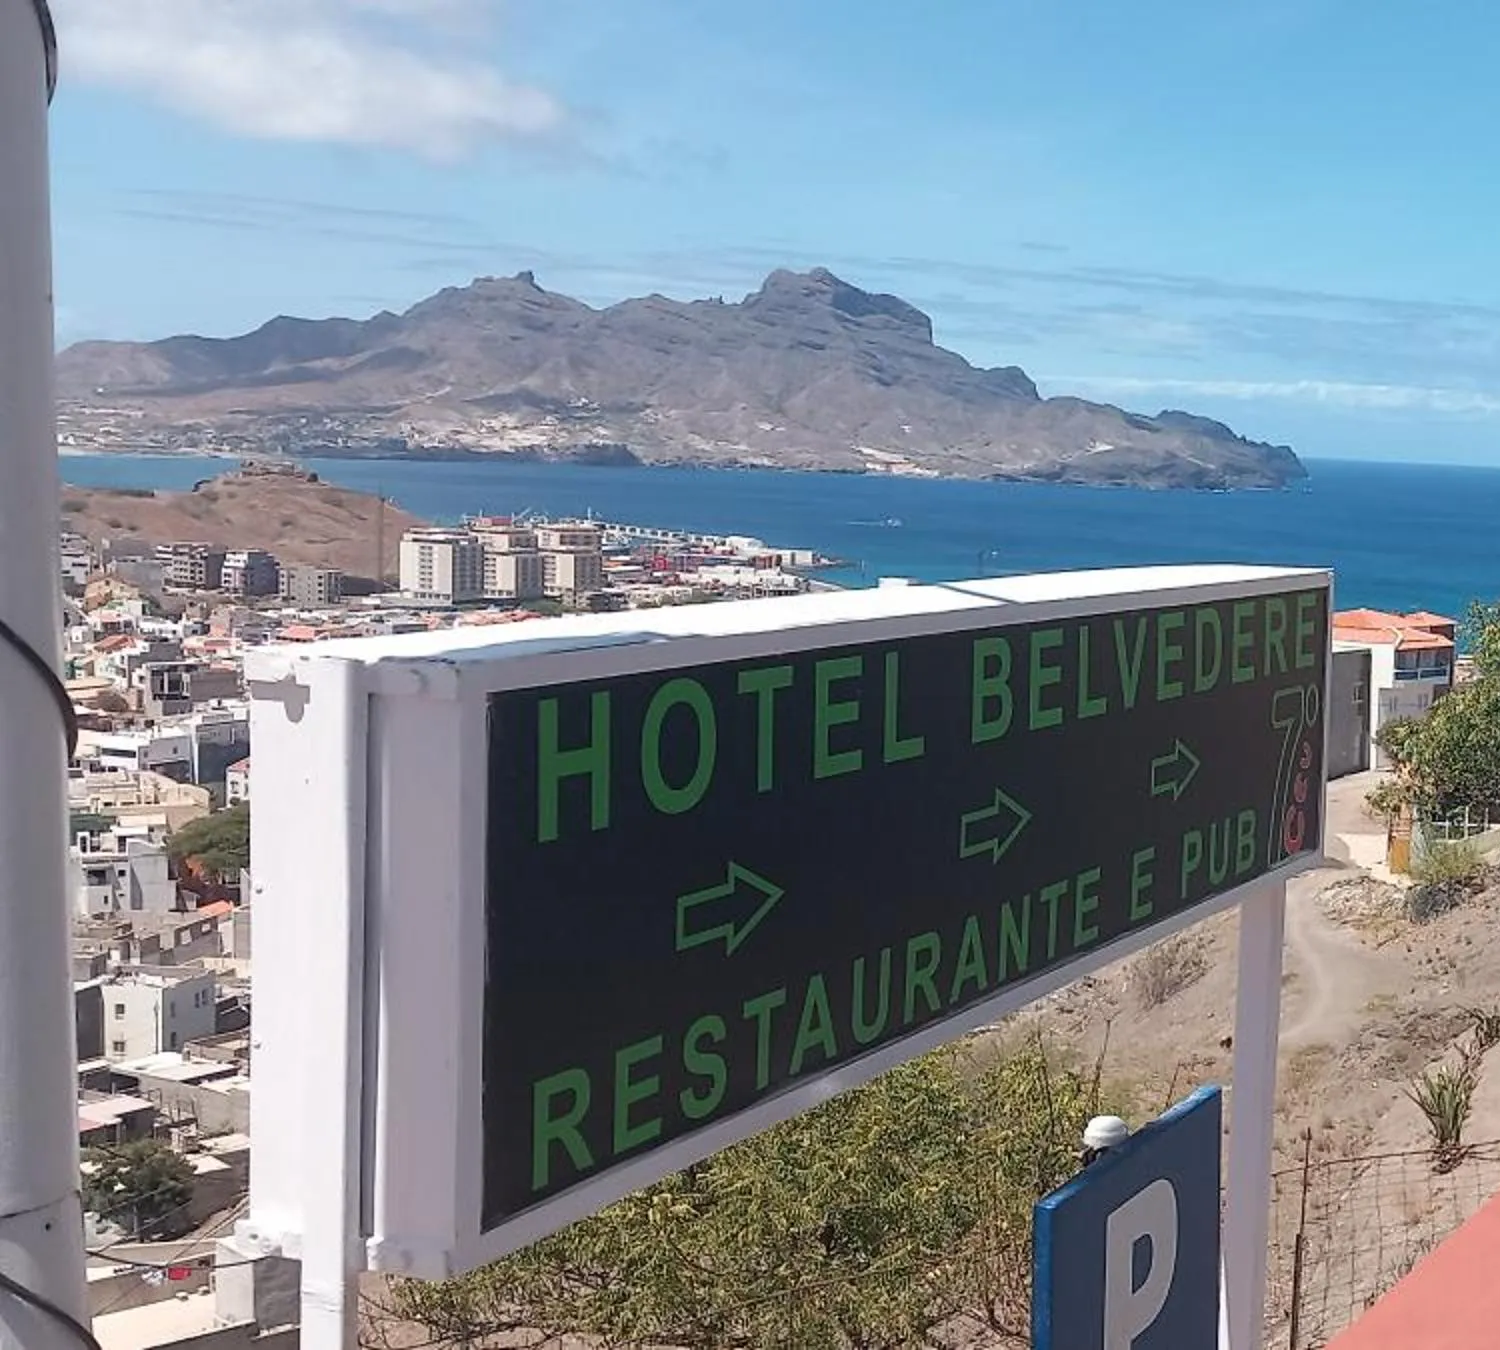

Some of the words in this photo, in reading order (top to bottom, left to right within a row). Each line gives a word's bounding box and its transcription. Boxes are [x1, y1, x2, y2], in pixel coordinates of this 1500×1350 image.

[535, 650, 926, 844] HOTEL
[970, 592, 1317, 745] BELVEDERE
[530, 866, 1102, 1192] RESTAURANTE
[1131, 847, 1155, 921] E
[1180, 808, 1257, 899] PUB
[1103, 1178, 1179, 1350] P
